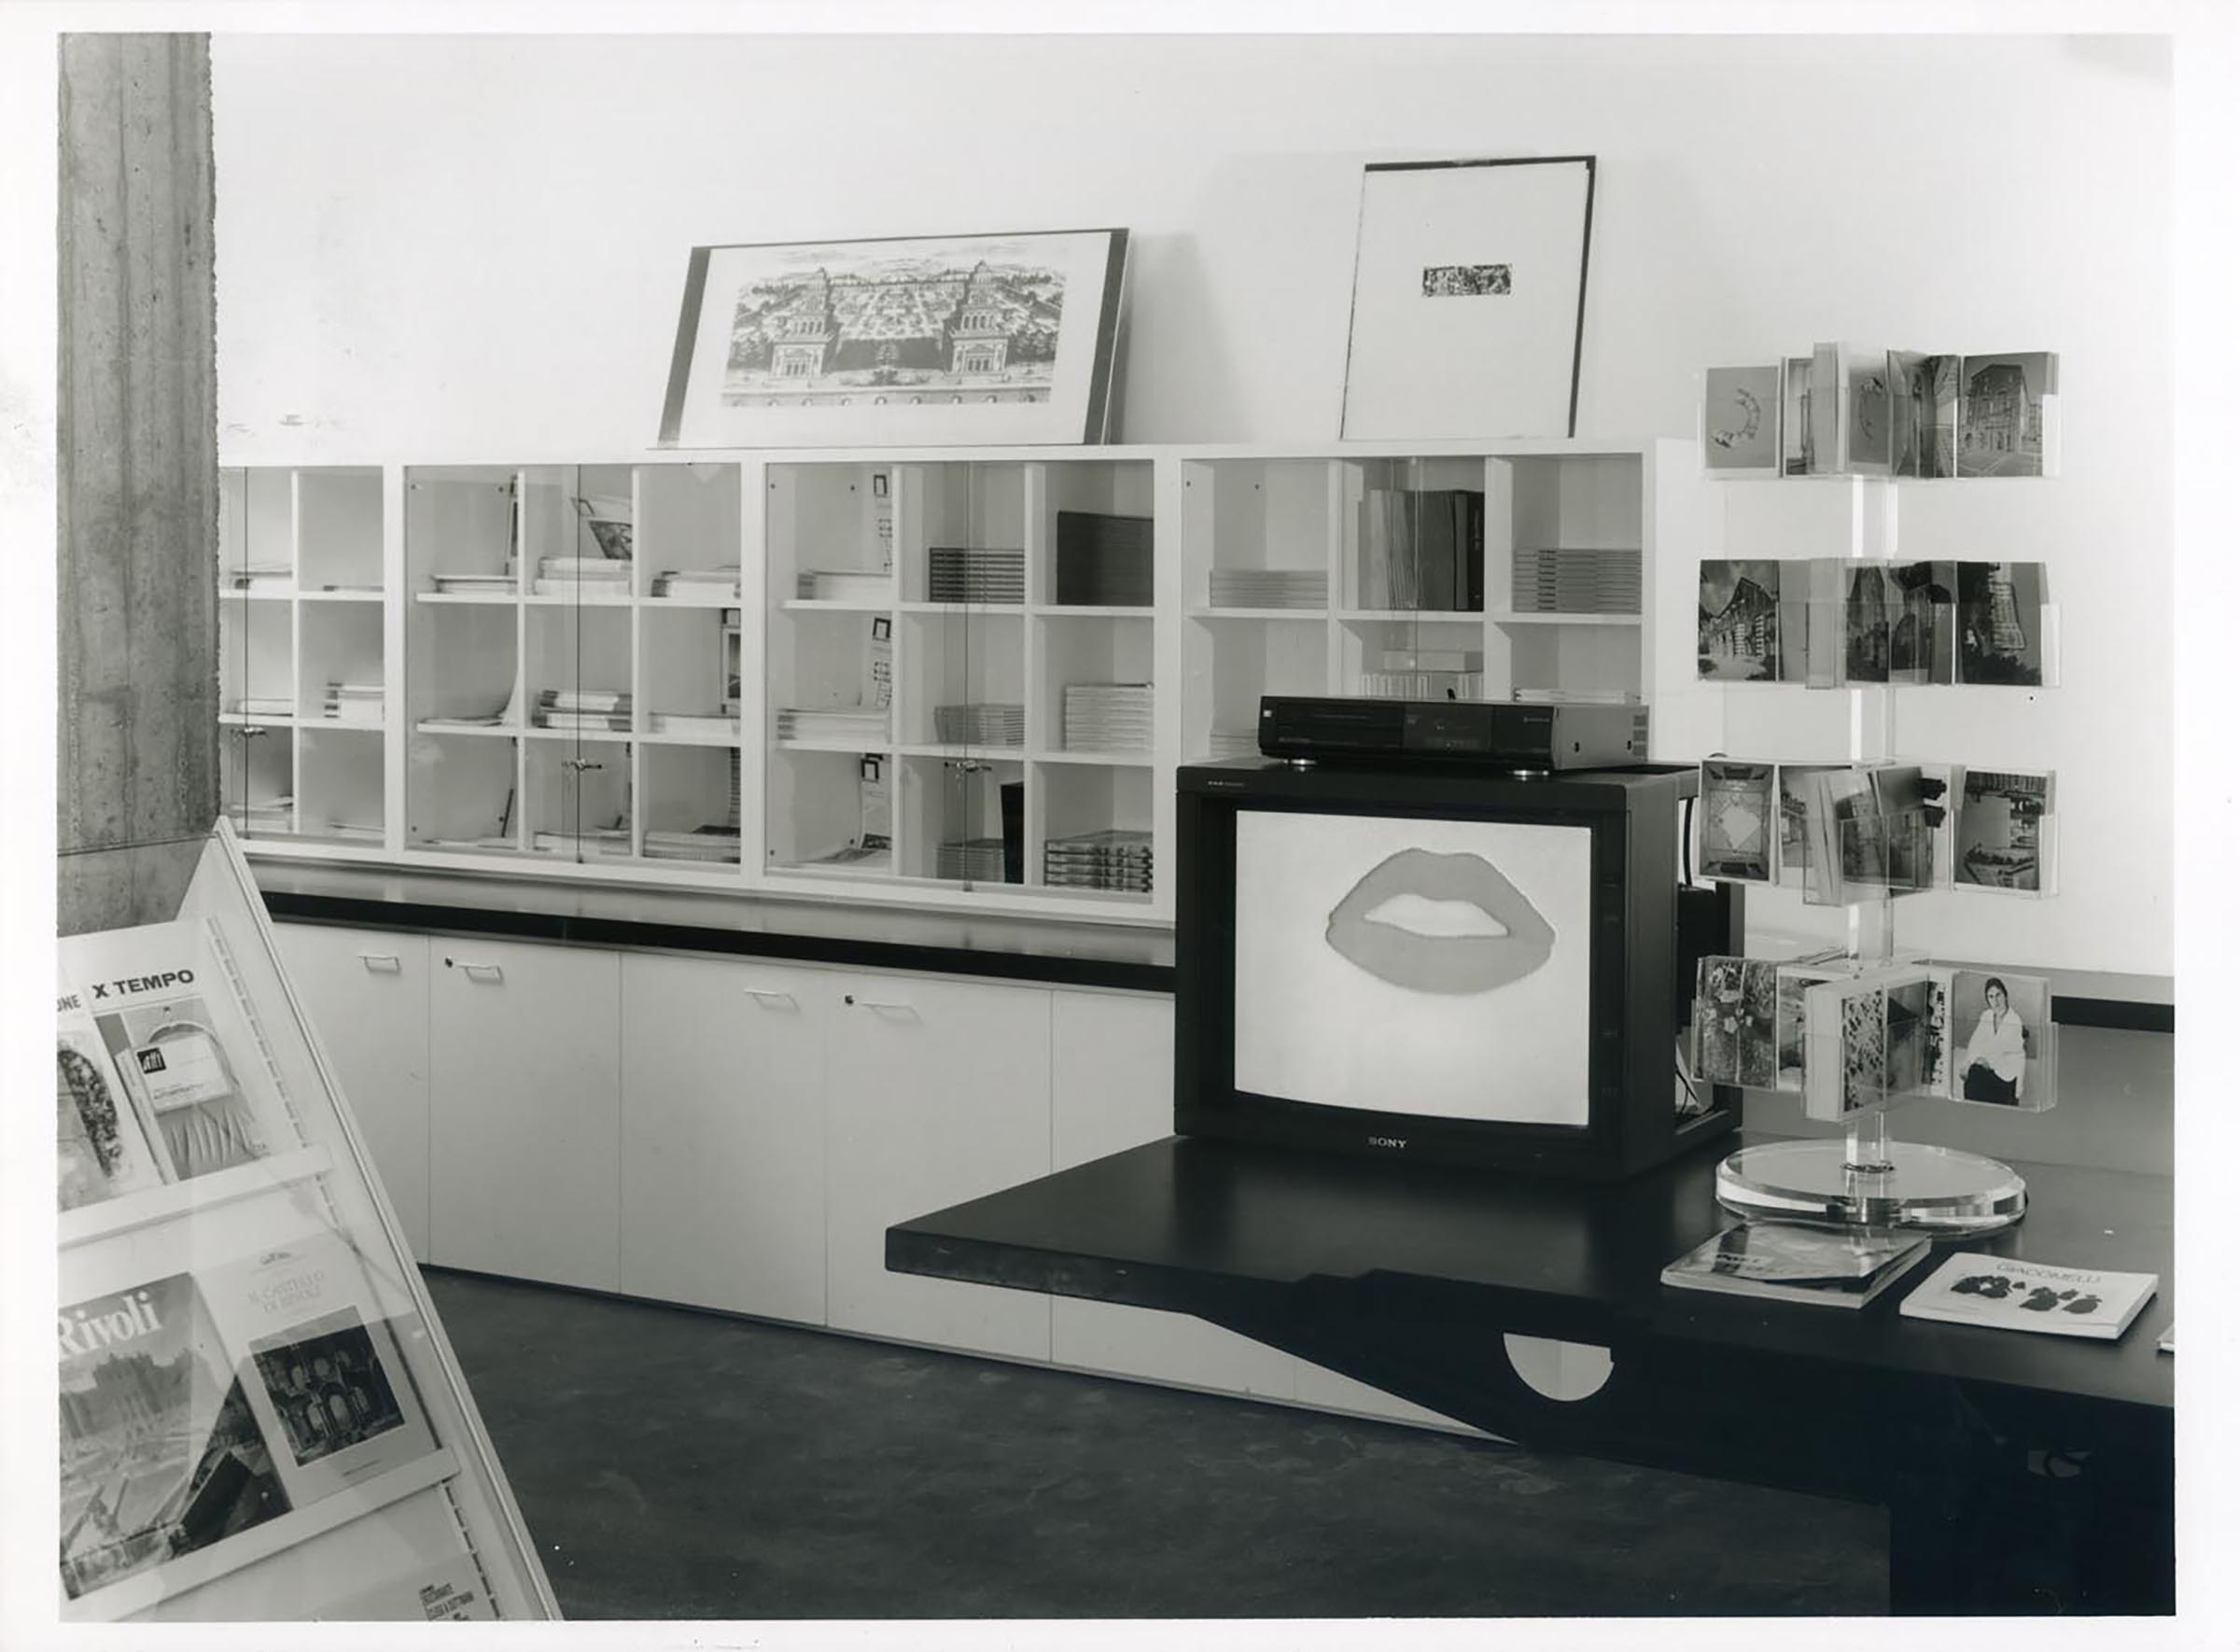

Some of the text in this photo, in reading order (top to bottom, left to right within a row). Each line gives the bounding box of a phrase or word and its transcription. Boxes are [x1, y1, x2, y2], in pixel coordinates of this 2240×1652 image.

[91, 969, 194, 999] X TEMPO
[1367, 1136, 1407, 1148] SONY
[58, 1290, 163, 1356] Rivoli
